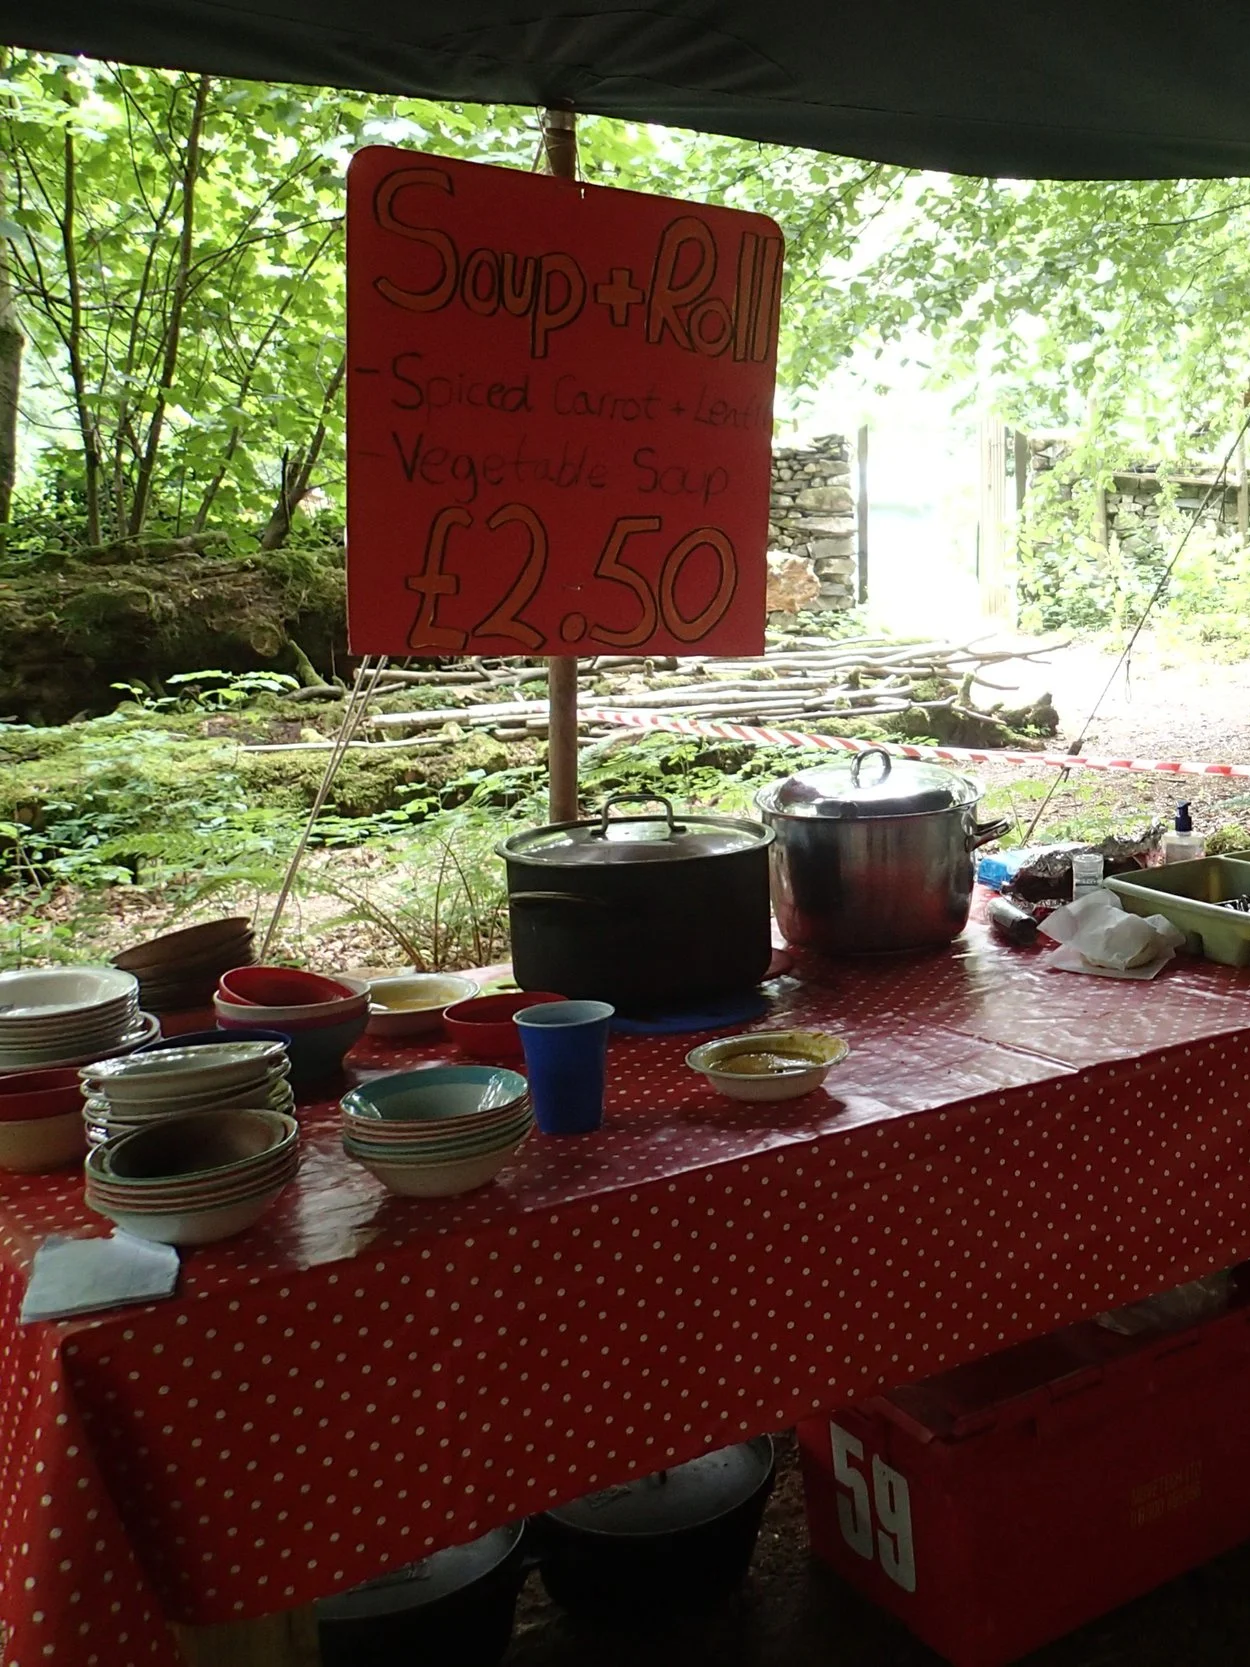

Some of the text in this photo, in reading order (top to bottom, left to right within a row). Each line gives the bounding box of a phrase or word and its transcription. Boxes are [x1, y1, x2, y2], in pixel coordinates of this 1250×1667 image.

[372, 167, 587, 359] Soup
[644, 215, 783, 363] Roll
[391, 352, 533, 421] Spiced
[552, 374, 661, 422] Carrot
[391, 430, 609, 504] Vegetable
[405, 503, 739, 651] £2.50
[830, 1419, 917, 1593] 59
